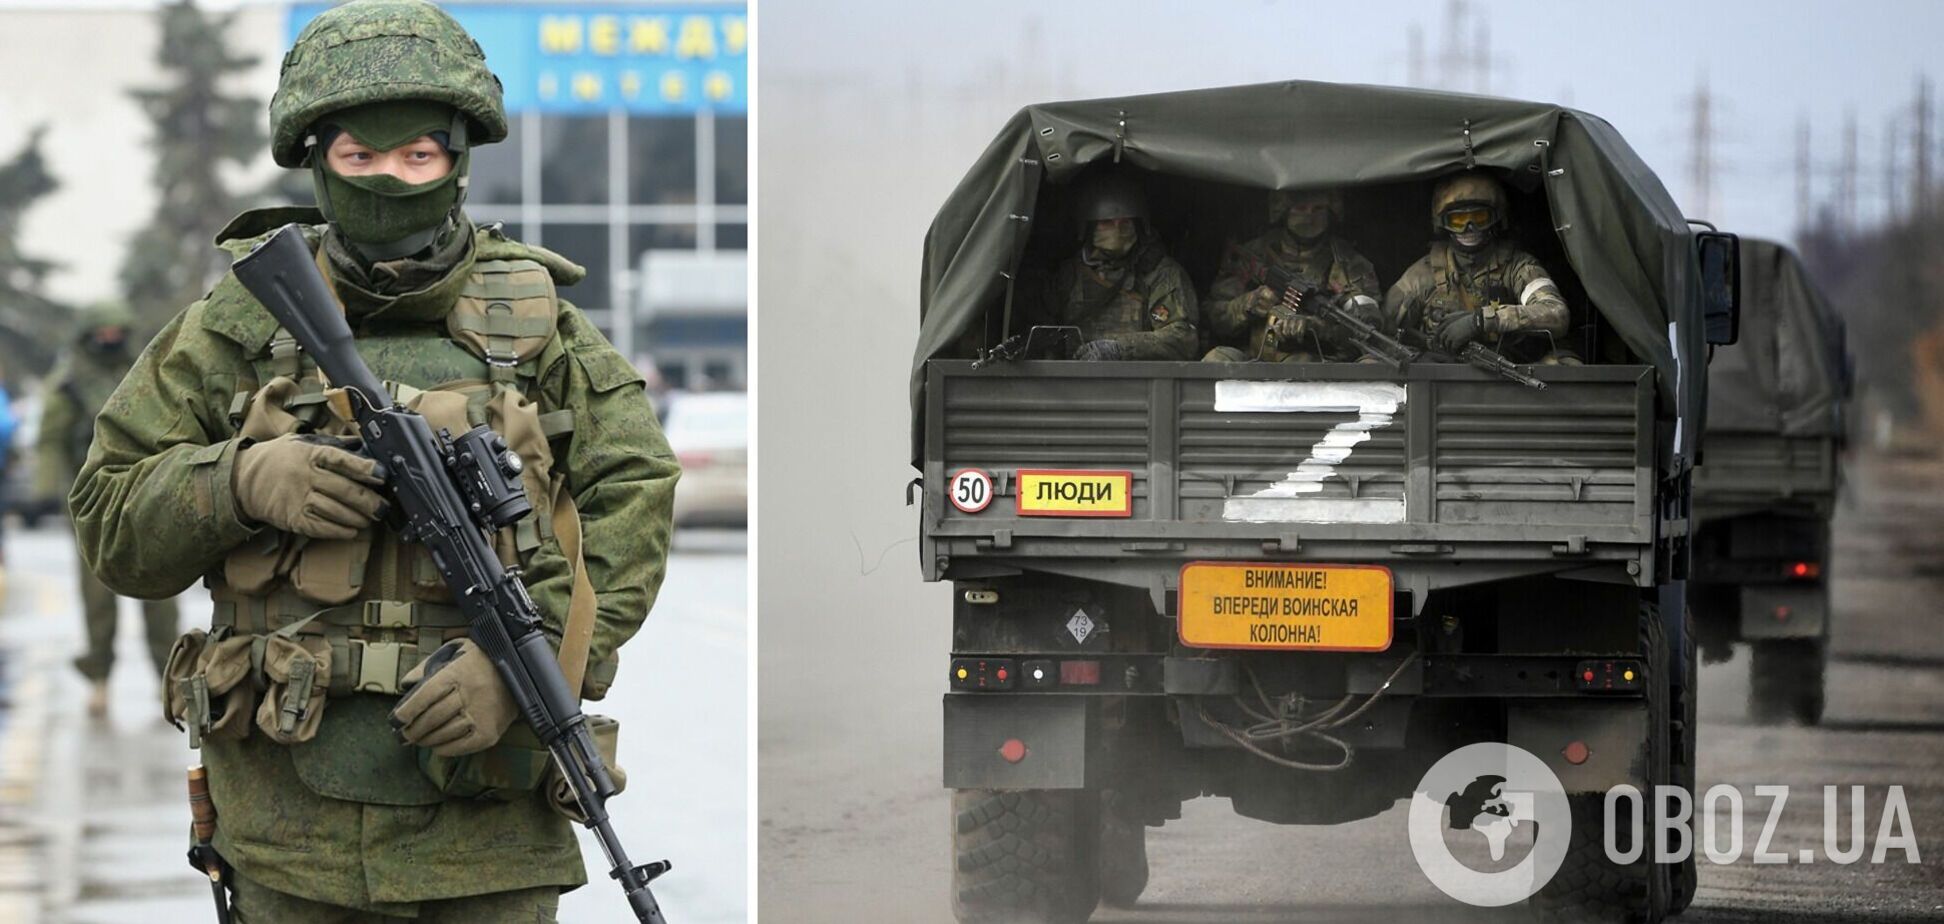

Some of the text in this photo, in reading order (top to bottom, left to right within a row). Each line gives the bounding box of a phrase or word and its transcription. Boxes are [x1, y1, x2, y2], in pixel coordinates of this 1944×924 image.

[1214, 379, 1408, 524] Z
[957, 477, 985, 503] 50
[1036, 482, 1112, 504] ЛЮДИ
[1245, 570, 1327, 590] ВНИМАНИЕ!
[1213, 596, 1358, 618] ВПЕРЕДИ ВОИНСКАЯ
[1074, 615, 1088, 626] 73
[1073, 627, 1087, 638] 19
[1249, 624, 1321, 644] КОЛОННА!
